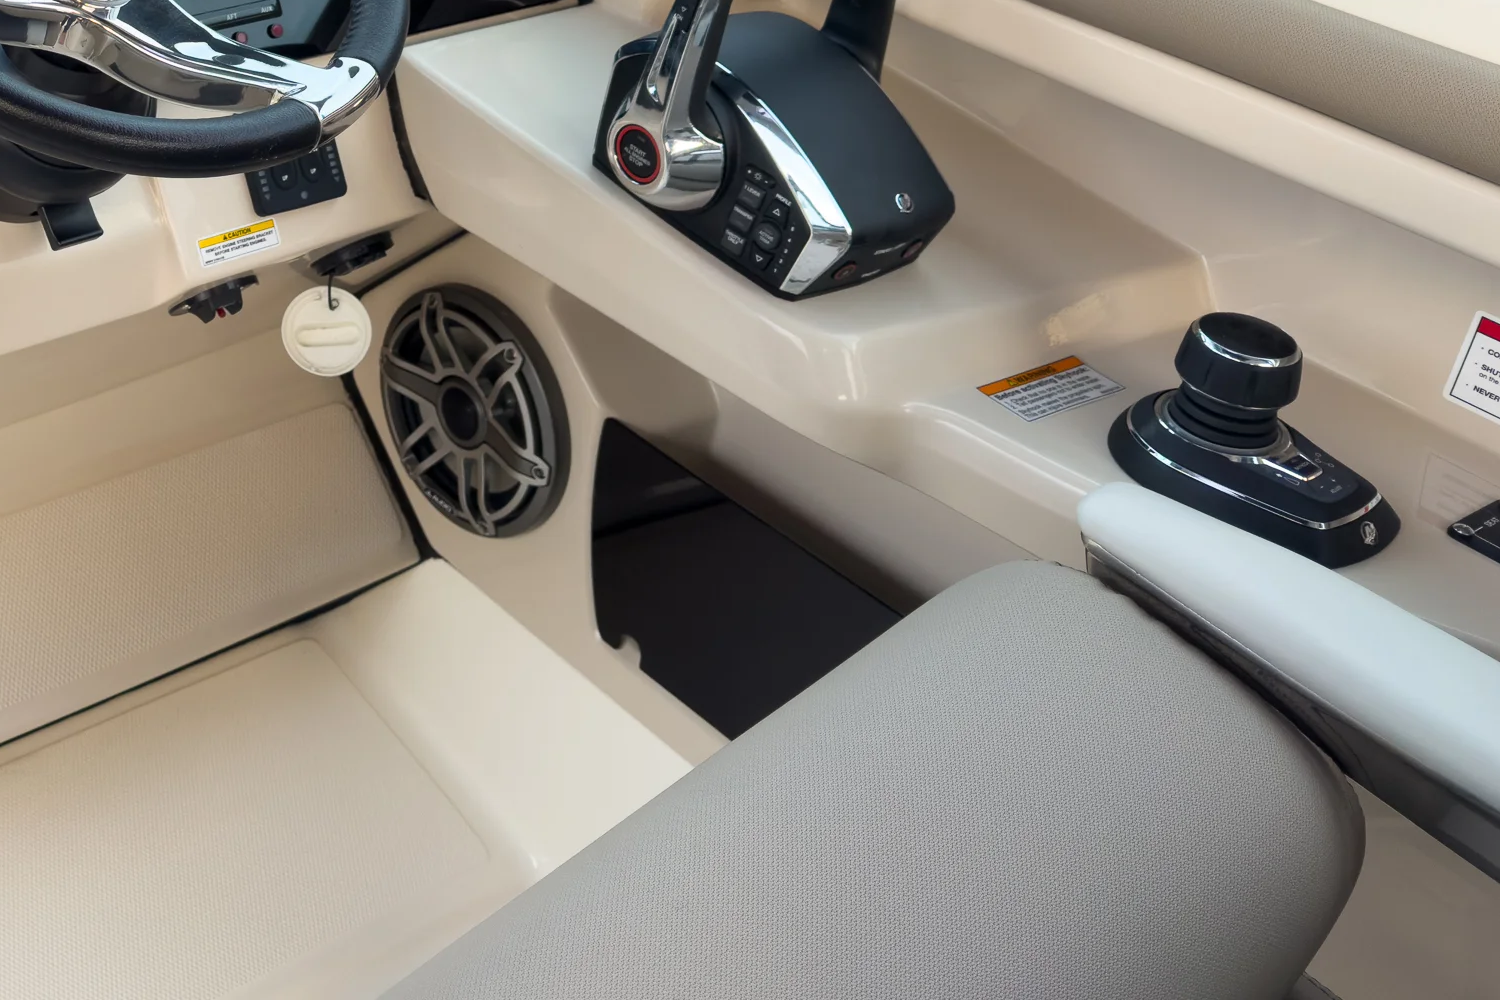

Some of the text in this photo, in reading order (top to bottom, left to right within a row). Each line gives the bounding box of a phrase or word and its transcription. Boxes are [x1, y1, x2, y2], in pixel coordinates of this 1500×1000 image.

[630, 144, 646, 157] START
[629, 155, 643, 166] STOP
[776, 193, 792, 207] PROFILE
[228, 228, 251, 238] CAUTION
[1014, 366, 1057, 383] WARNING
[994, 389, 1023, 400] Before
[1473, 386, 1500, 402] NEVER
